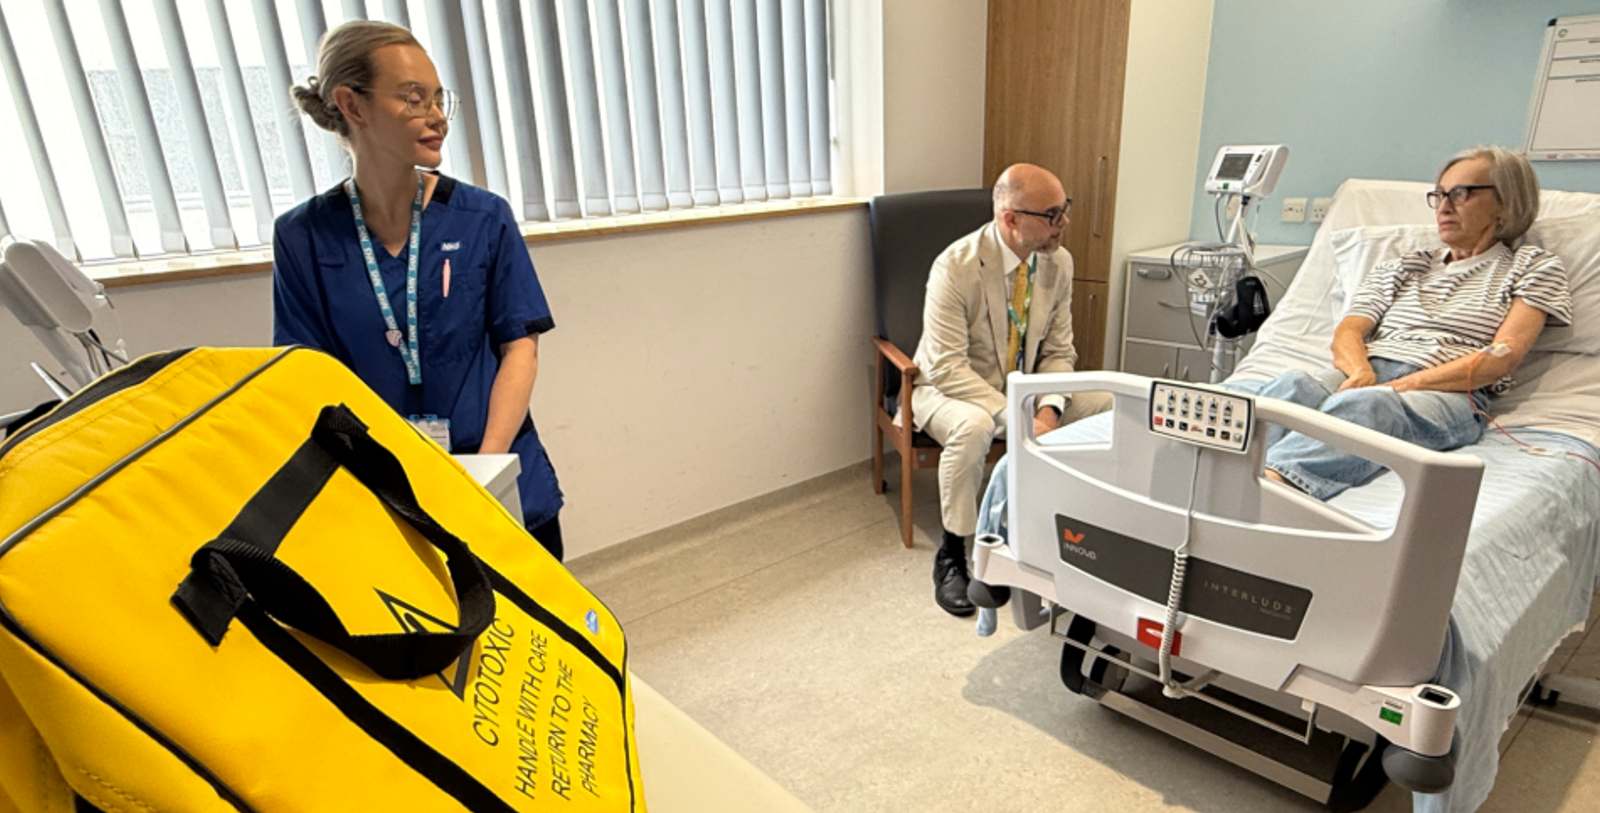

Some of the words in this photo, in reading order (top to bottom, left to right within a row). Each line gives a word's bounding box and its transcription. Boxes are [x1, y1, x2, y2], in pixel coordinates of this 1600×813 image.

[363, 247, 375, 264] NHS
[528, 629, 547, 673] CARE
[556, 658, 573, 693] THE
[472, 618, 514, 747] CYTOTOXIC
[516, 671, 543, 722] WITH
[551, 695, 571, 722] TO
[514, 719, 538, 799] HANDLE
[548, 722, 571, 801] RETURN
[578, 695, 601, 798] PHARMACY
